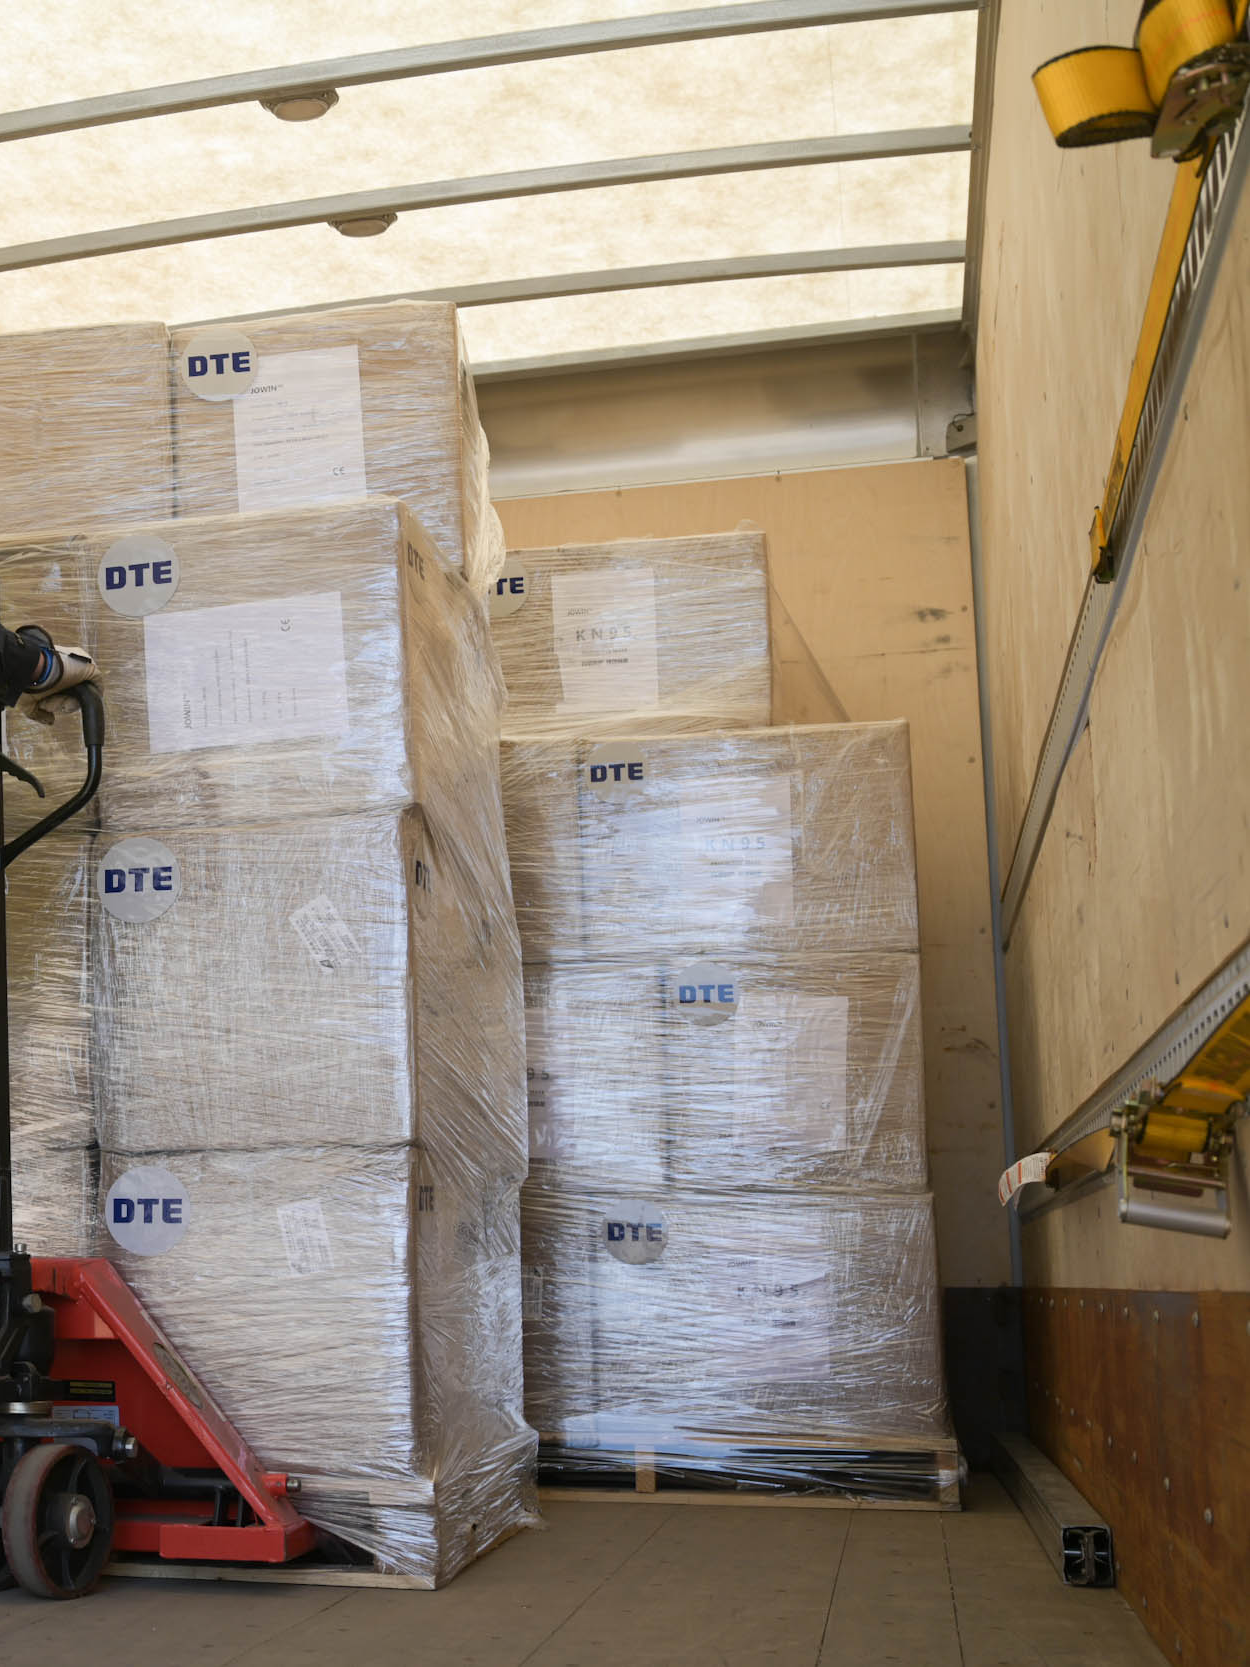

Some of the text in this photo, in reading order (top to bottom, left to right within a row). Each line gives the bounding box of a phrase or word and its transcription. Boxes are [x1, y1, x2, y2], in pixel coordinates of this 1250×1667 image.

[187, 351, 251, 378] DTE
[105, 560, 172, 591] DTE
[488, 576, 525, 596] TE
[590, 762, 644, 783] DTE
[104, 866, 173, 894] DTE
[678, 983, 735, 1004] DTE
[112, 1197, 183, 1224] DTE
[606, 1221, 663, 1243] DTE
